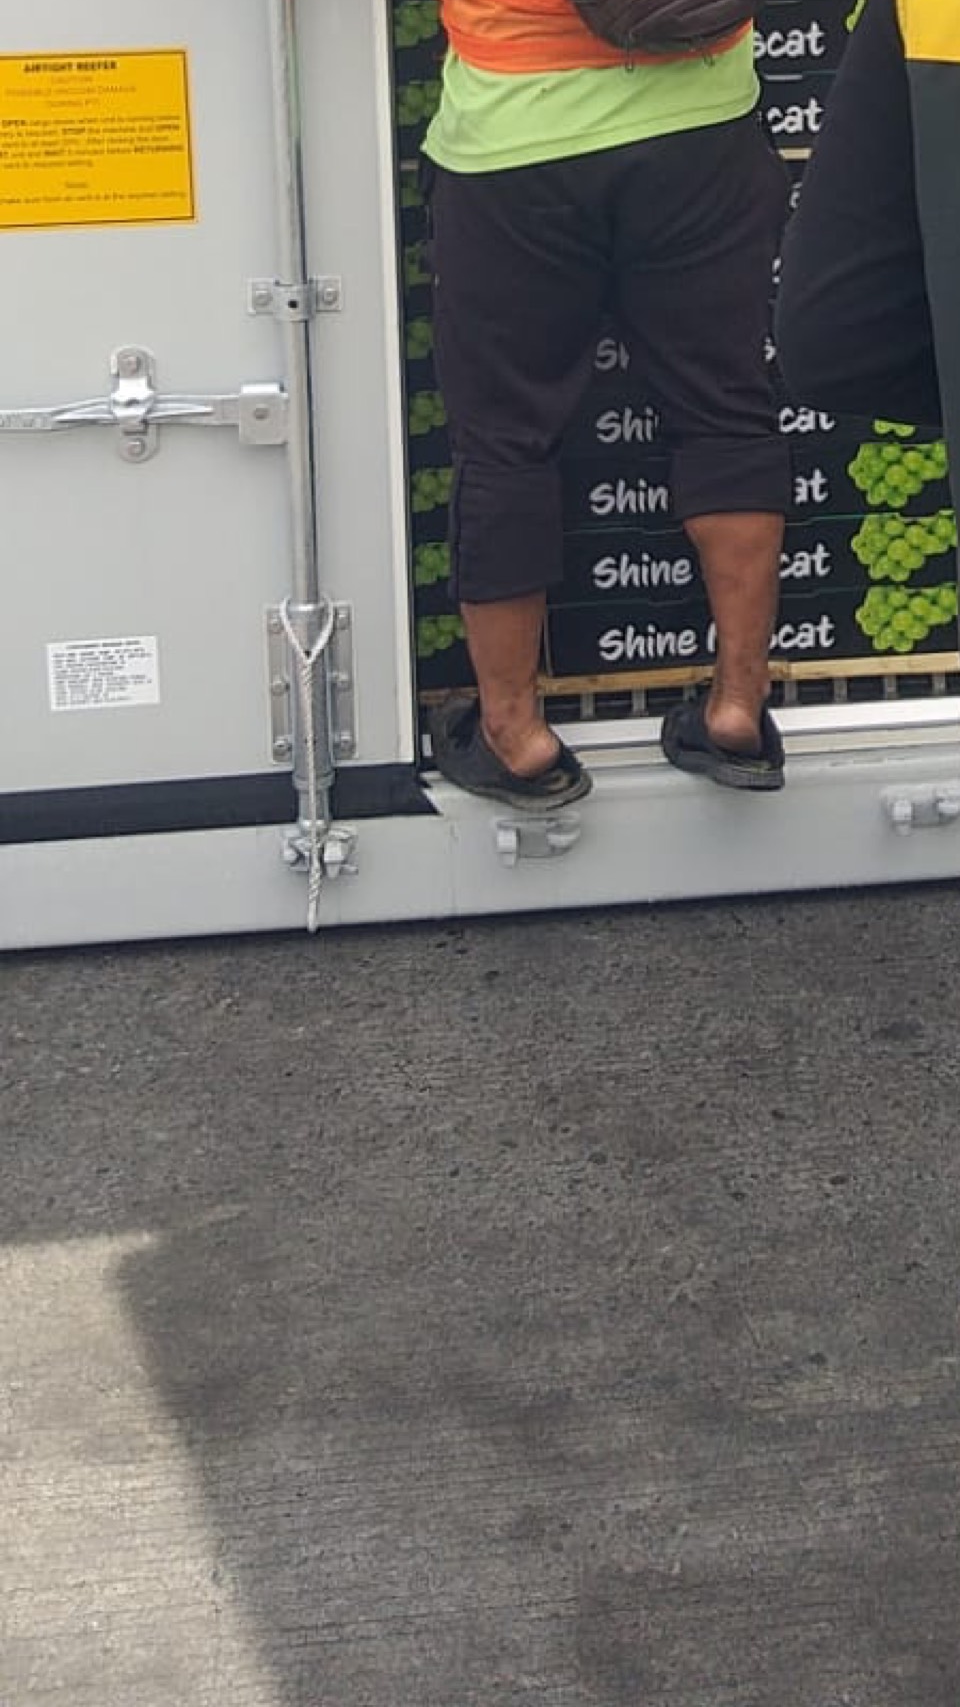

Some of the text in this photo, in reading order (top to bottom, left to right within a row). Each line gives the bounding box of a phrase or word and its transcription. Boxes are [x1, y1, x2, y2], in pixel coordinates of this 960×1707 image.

[752, 21, 825, 58] scat
[767, 97, 823, 134] cat
[596, 406, 659, 443] Shi
[589, 479, 668, 516] Shin
[592, 543, 830, 589] Shine cat
[598, 624, 698, 661] Shine
